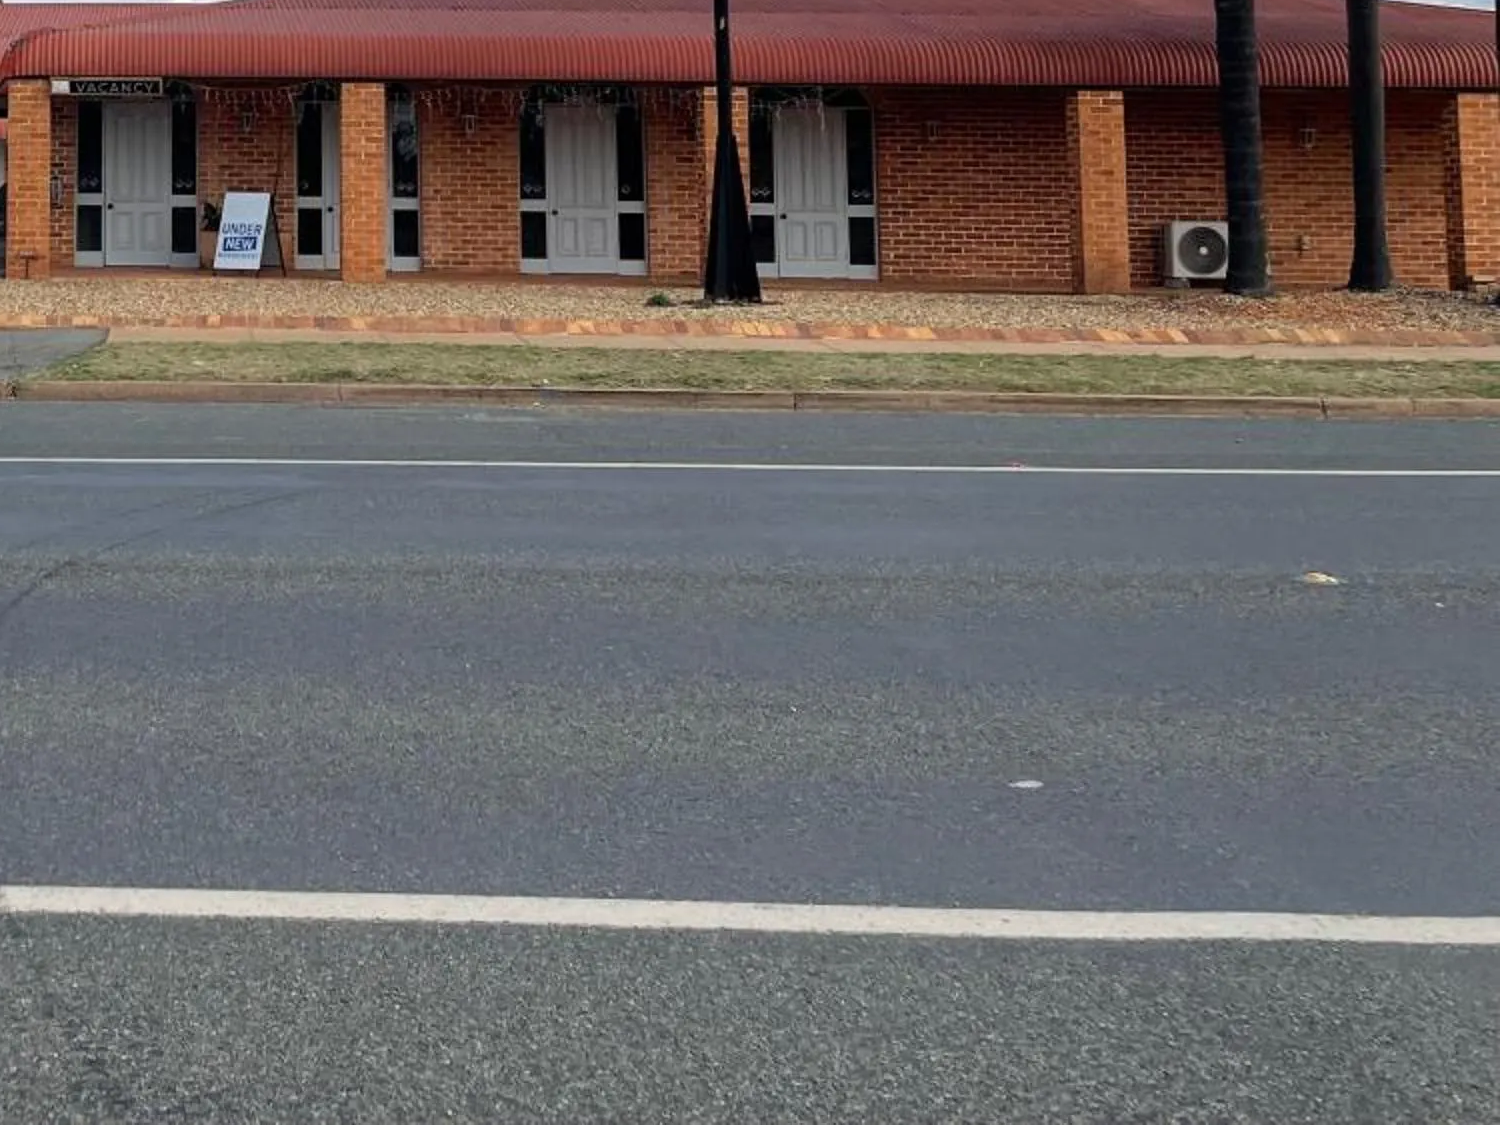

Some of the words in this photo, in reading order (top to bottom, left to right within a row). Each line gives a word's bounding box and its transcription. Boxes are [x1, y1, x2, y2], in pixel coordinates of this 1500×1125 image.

[75, 82, 154, 92] VACANCY
[222, 222, 262, 235] UNDER
[225, 238, 255, 250] NEW
